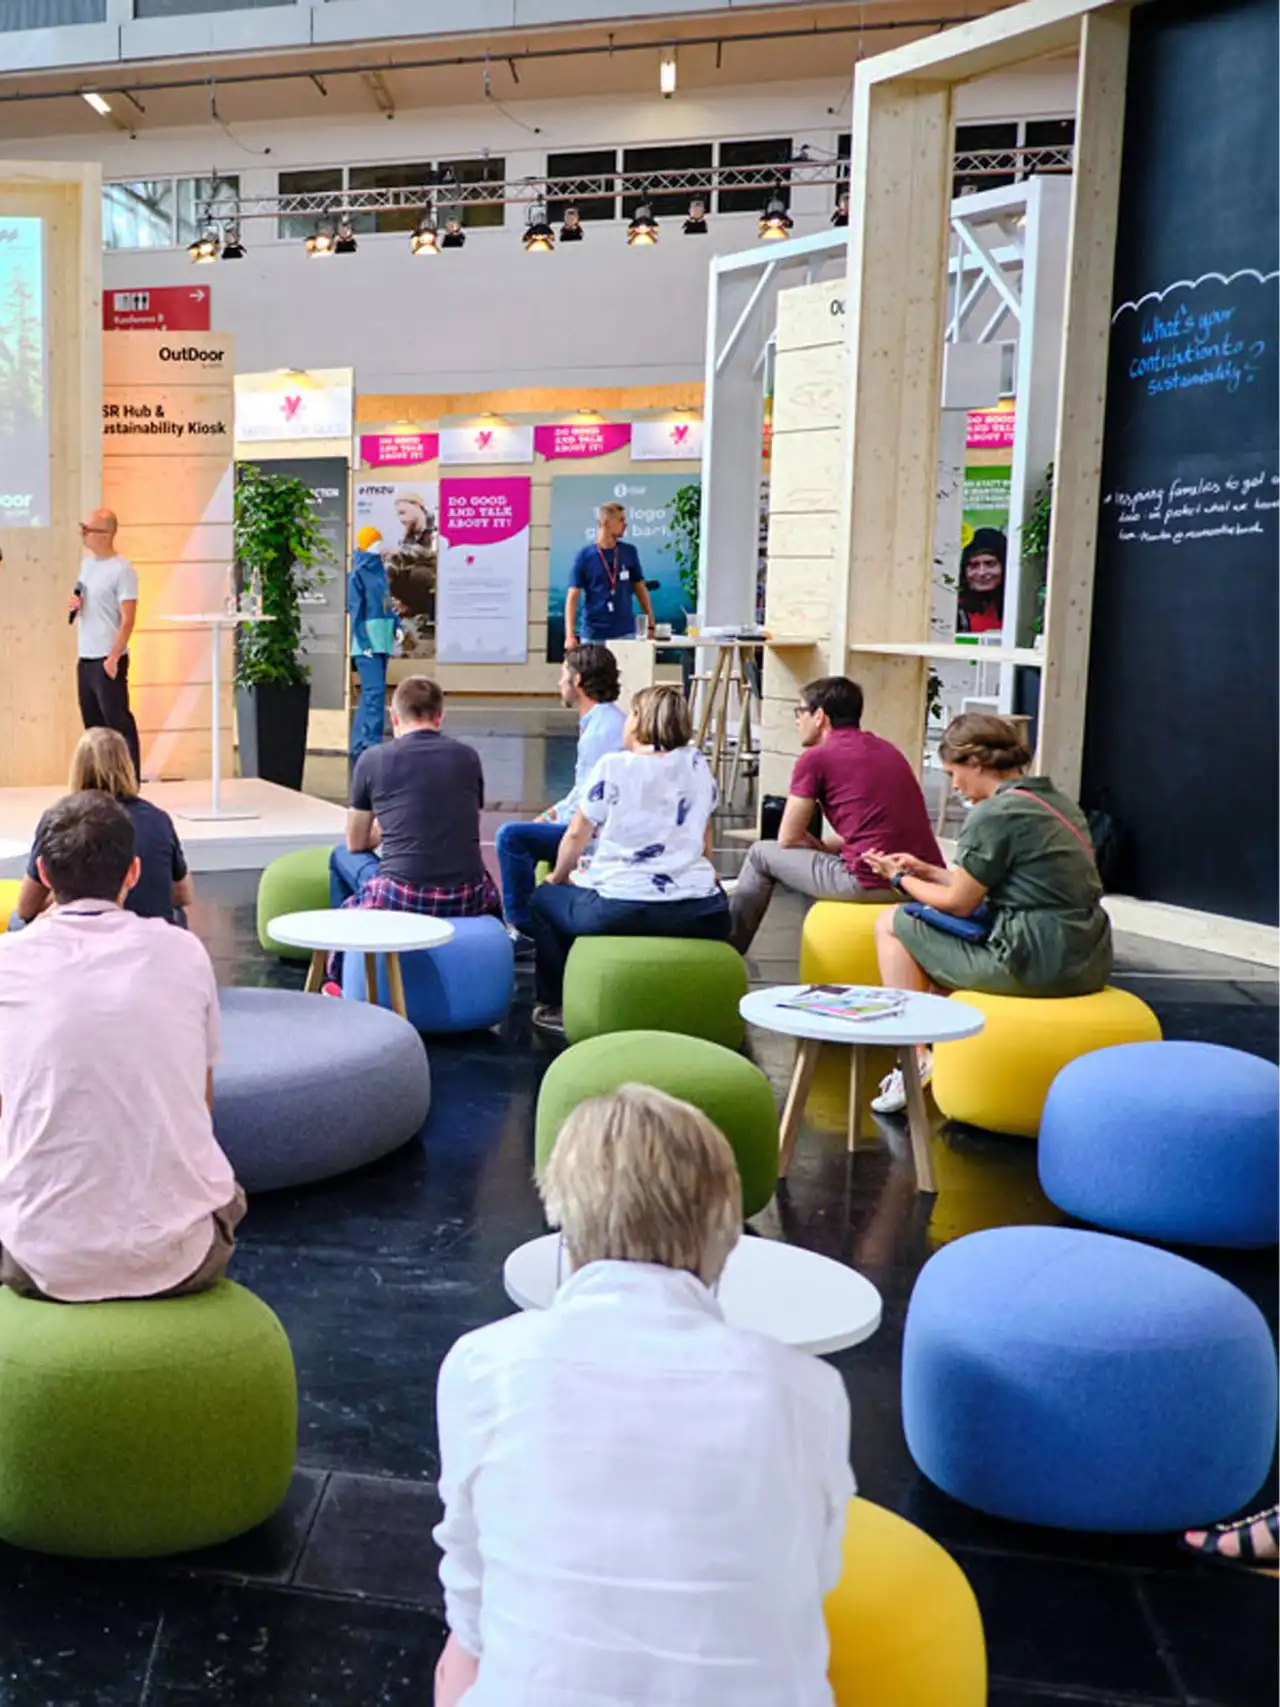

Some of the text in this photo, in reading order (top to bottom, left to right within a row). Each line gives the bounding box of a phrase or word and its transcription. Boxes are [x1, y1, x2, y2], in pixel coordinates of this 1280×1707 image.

[159, 347, 225, 362] OutDoor
[102, 404, 165, 418] SR Hub &
[104, 421, 184, 438] stainability
[188, 421, 226, 435] Kiosk
[554, 443, 585, 452] ABOUT
[448, 495, 507, 506] DO GOOD
[447, 506, 513, 517] AND TALK
[629, 507, 666, 522] logo
[447, 518, 512, 528] ABOUT IT!
